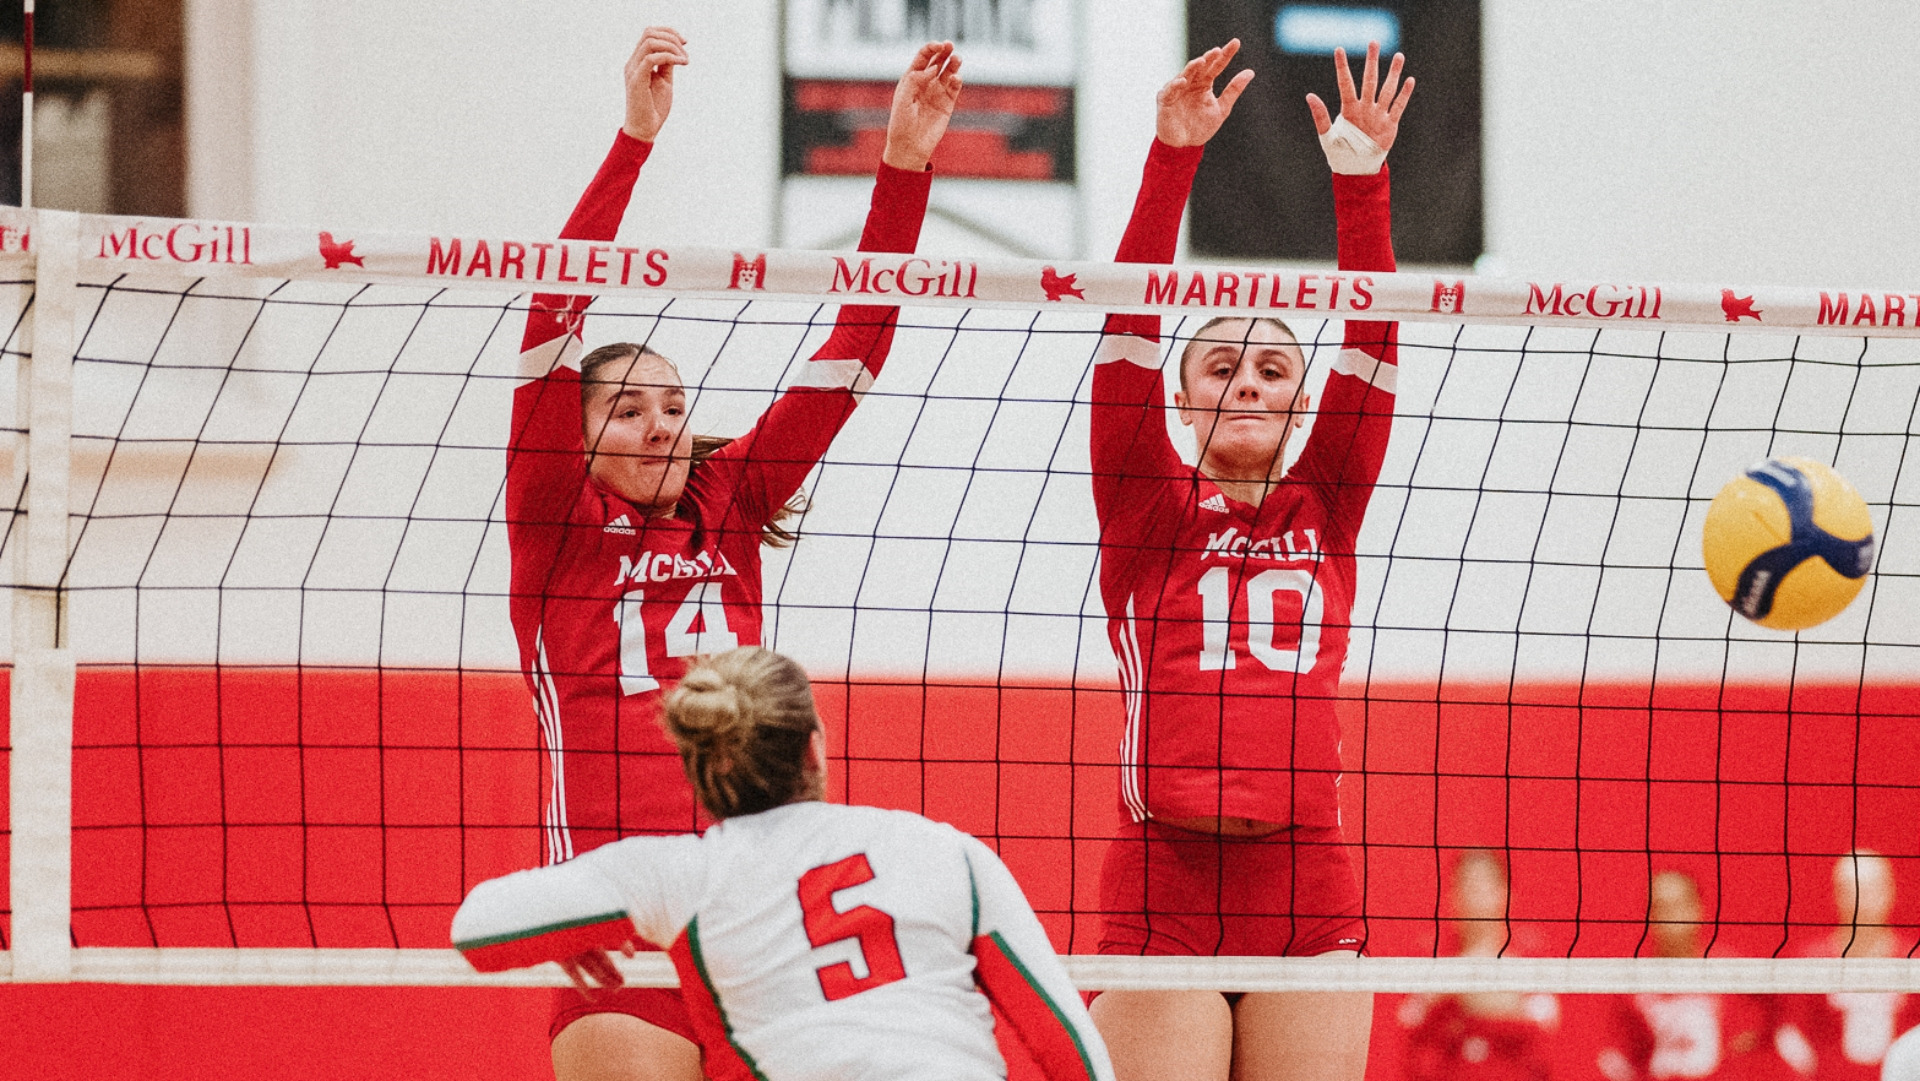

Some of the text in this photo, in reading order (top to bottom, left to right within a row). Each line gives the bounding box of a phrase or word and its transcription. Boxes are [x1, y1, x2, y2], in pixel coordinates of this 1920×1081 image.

[99, 222, 253, 265] McGill
[426, 236, 669, 287] MARTLETS
[828, 256, 978, 299] McGill
[1144, 269, 1374, 311] MARTLETS
[1522, 281, 1663, 319] McGill
[1200, 526, 1326, 563] MCGILL
[613, 582, 739, 697] 14
[1197, 566, 1324, 675] 10
[797, 853, 907, 1002] 5
